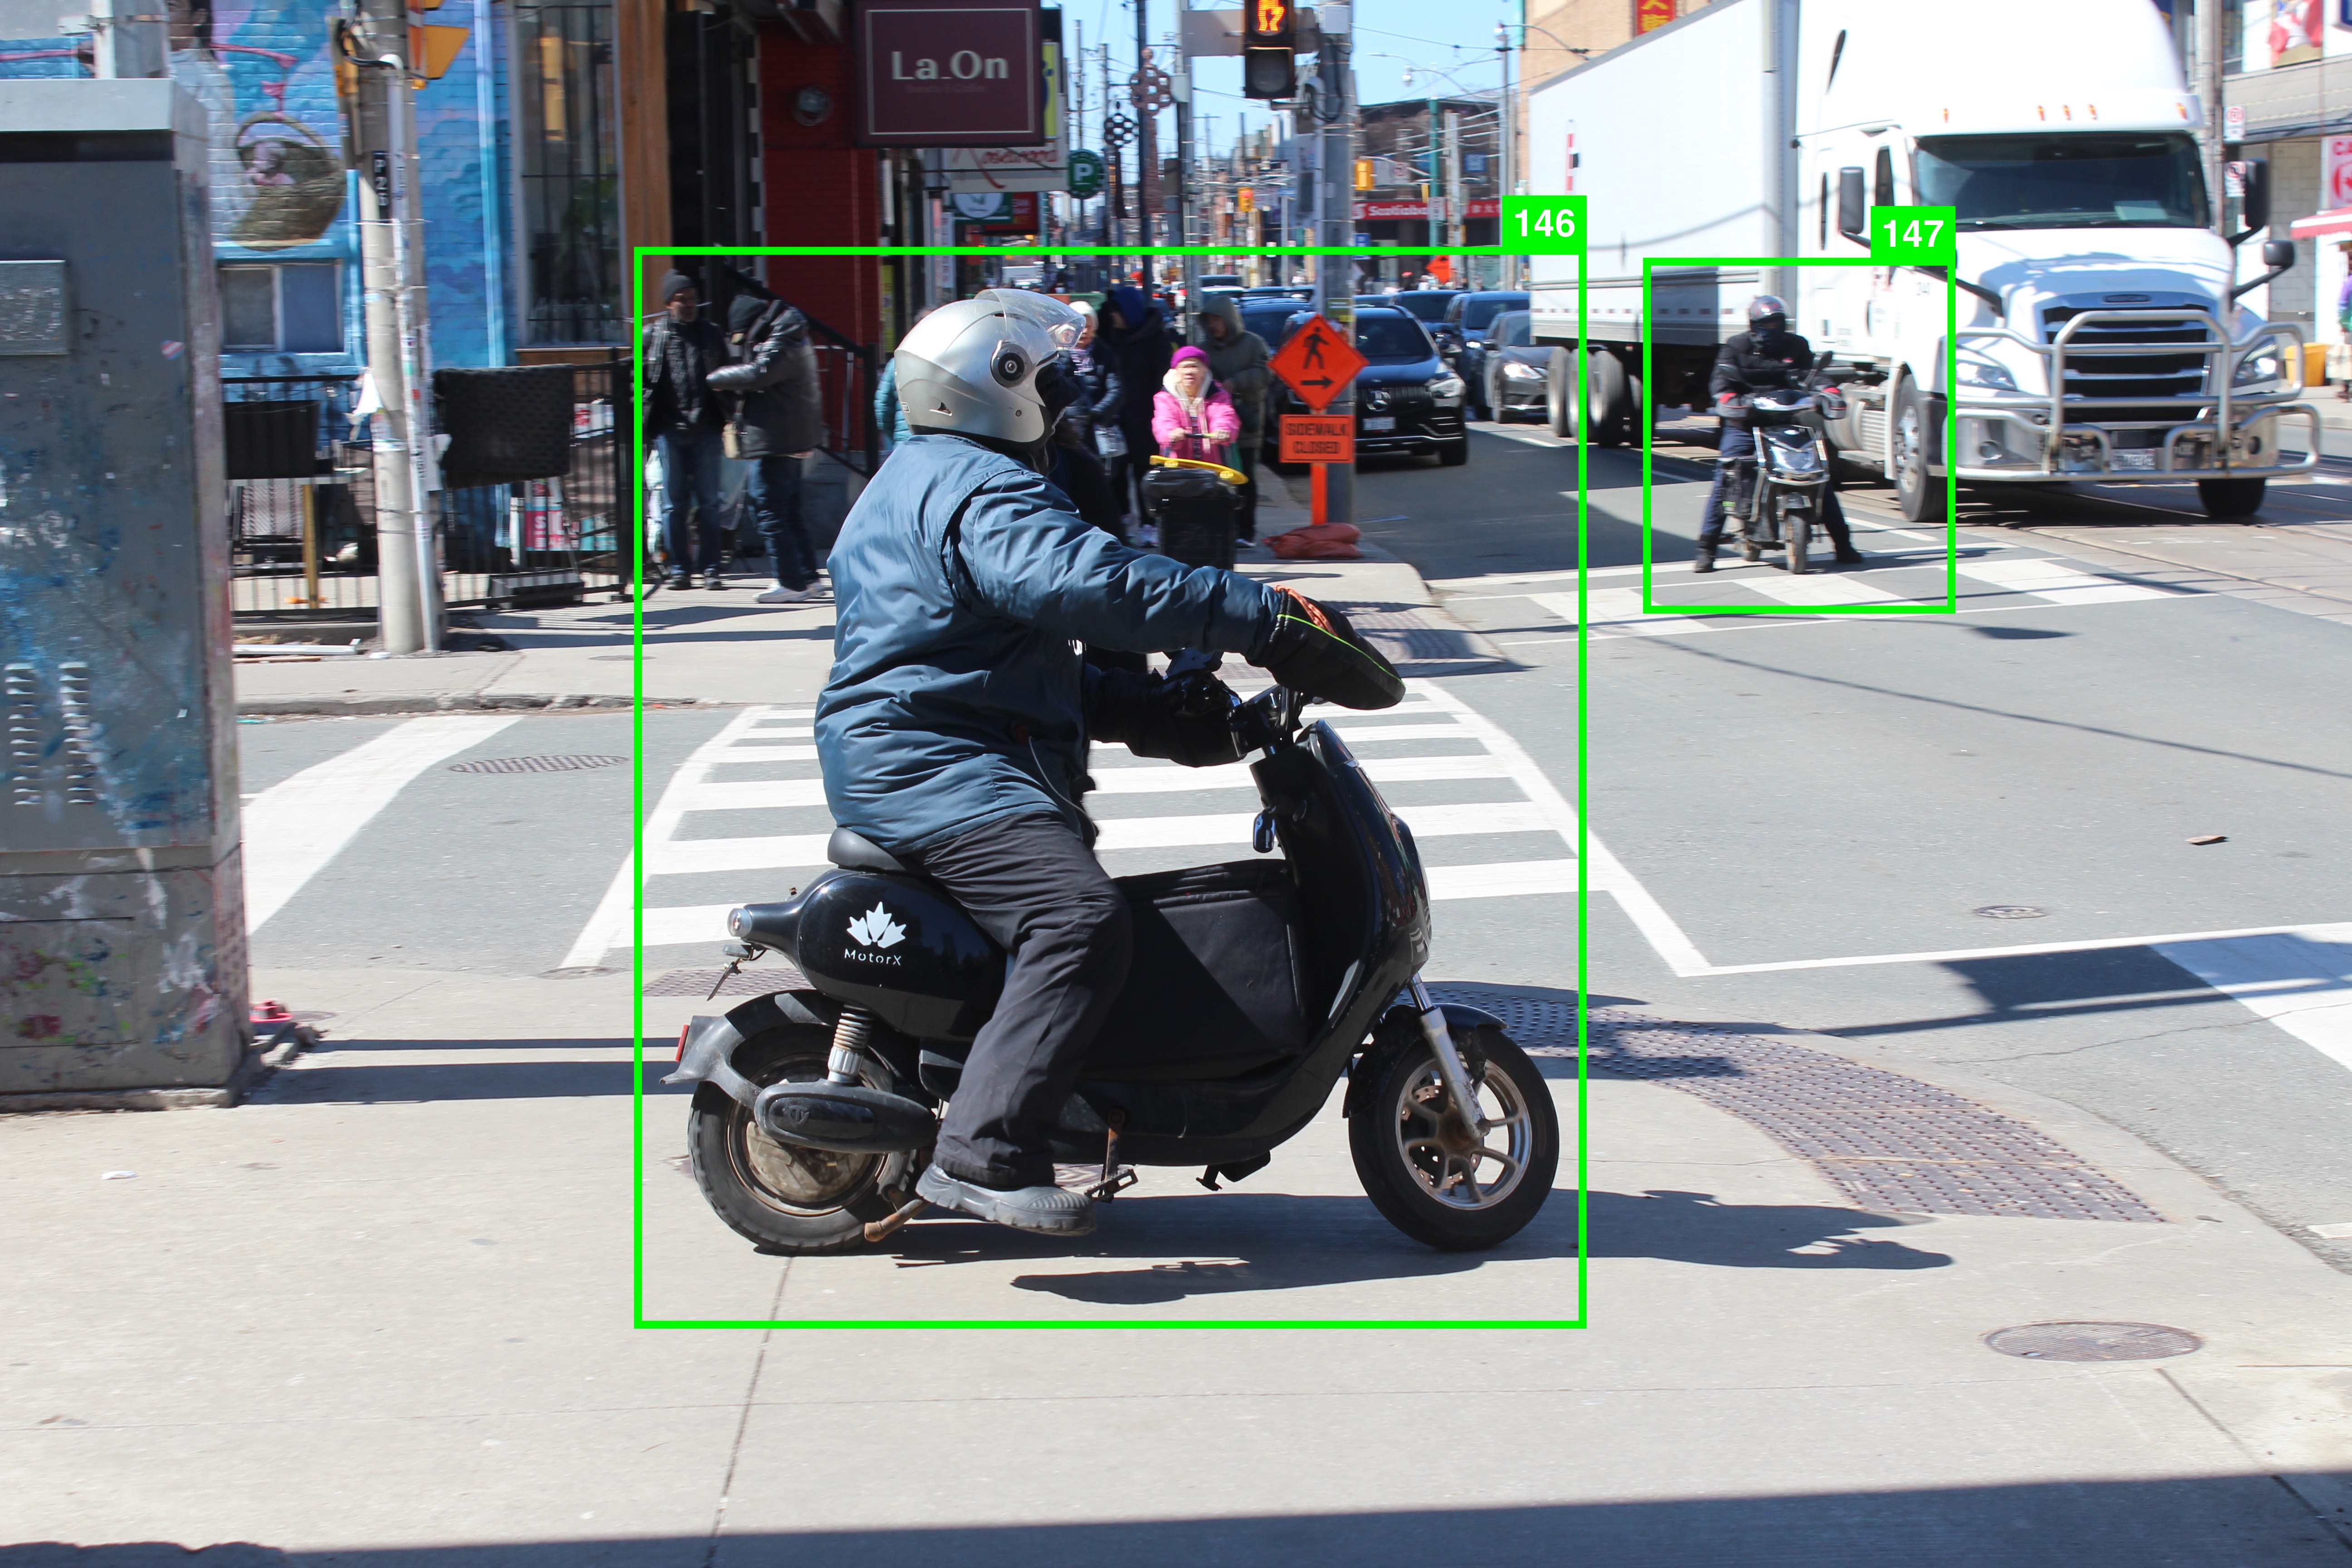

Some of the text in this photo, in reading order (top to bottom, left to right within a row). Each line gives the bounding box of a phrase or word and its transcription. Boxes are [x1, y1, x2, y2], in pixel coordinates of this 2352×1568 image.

[1073, 163, 1093, 181] P
[1286, 423, 1349, 436] SIDEWALK
[1293, 441, 1341, 453] CLOSED
[844, 948, 902, 966] MotorX
